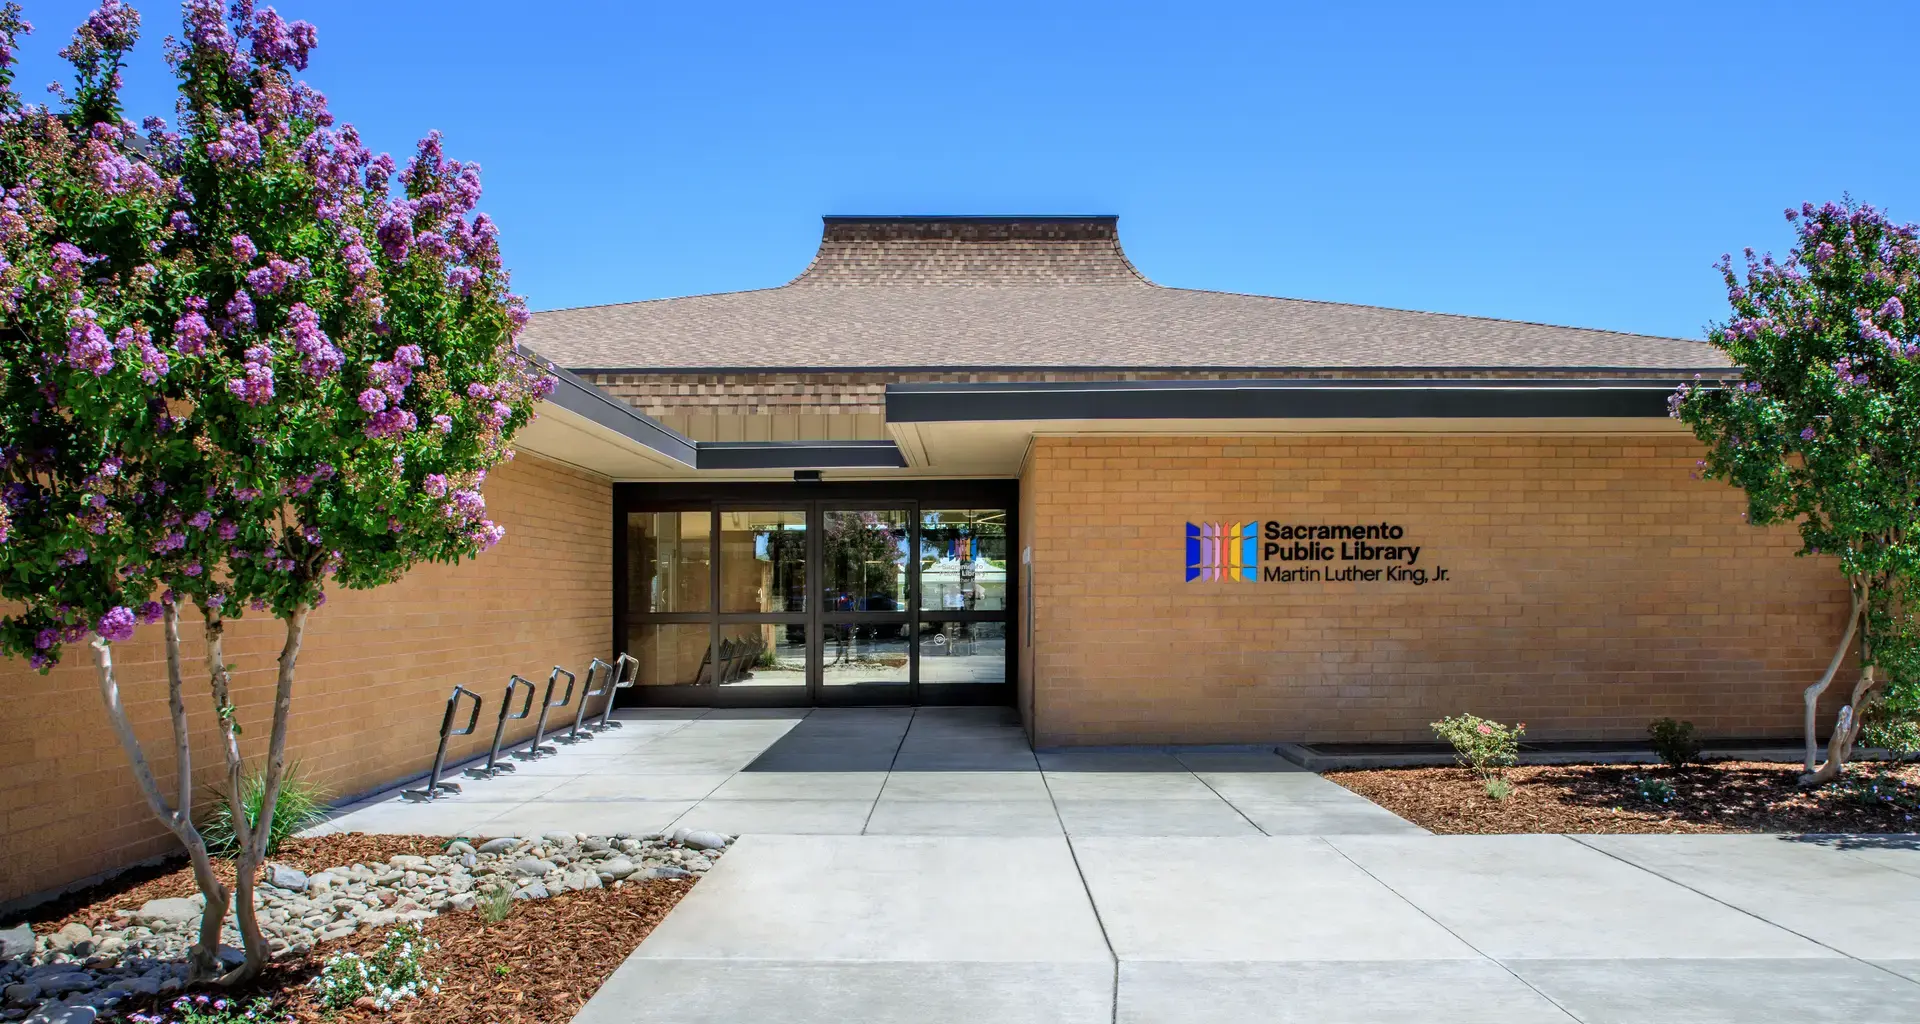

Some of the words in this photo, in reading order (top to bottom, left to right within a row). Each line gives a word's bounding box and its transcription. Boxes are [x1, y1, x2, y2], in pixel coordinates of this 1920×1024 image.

[1264, 521, 1404, 540] Sacramento
[1264, 542, 1335, 561] Public
[1341, 542, 1421, 565] Library
[942, 563, 983, 571] Sacrameto
[1264, 566, 1321, 582] Martin
[1325, 566, 1383, 582] Luther
[1386, 566, 1429, 586] King,
[1431, 566, 1450, 582] Jr.
